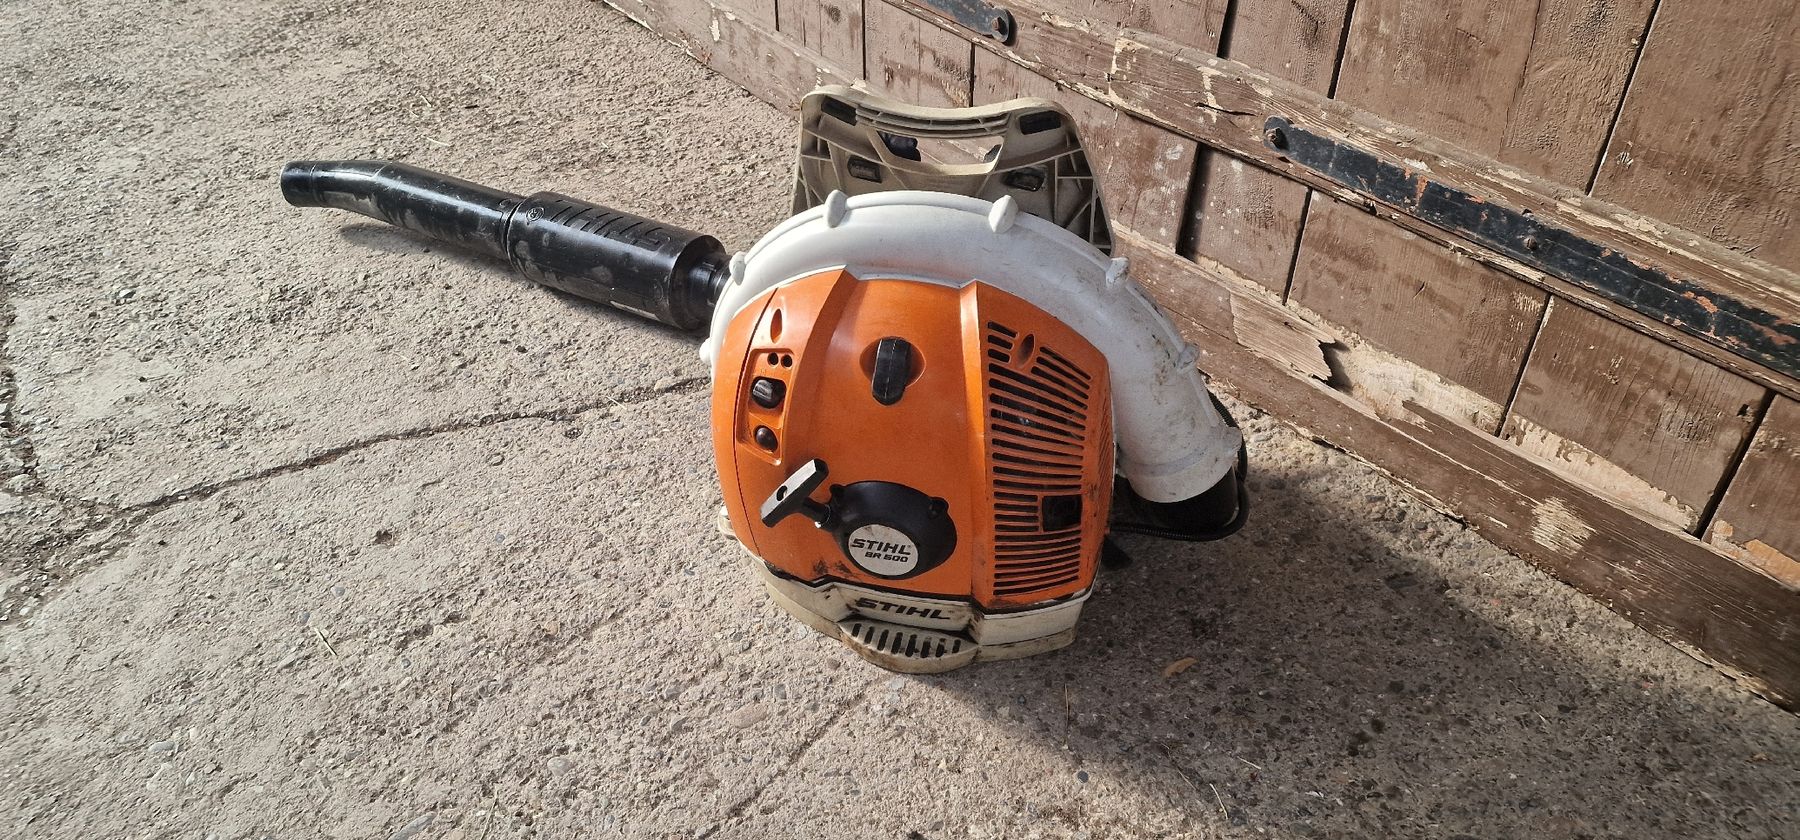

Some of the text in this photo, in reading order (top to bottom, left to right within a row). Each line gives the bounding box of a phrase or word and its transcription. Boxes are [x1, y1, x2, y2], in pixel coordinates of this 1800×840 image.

[851, 538, 911, 555] STIHL
[864, 551, 881, 559] BR
[855, 597, 950, 620] STIHL
